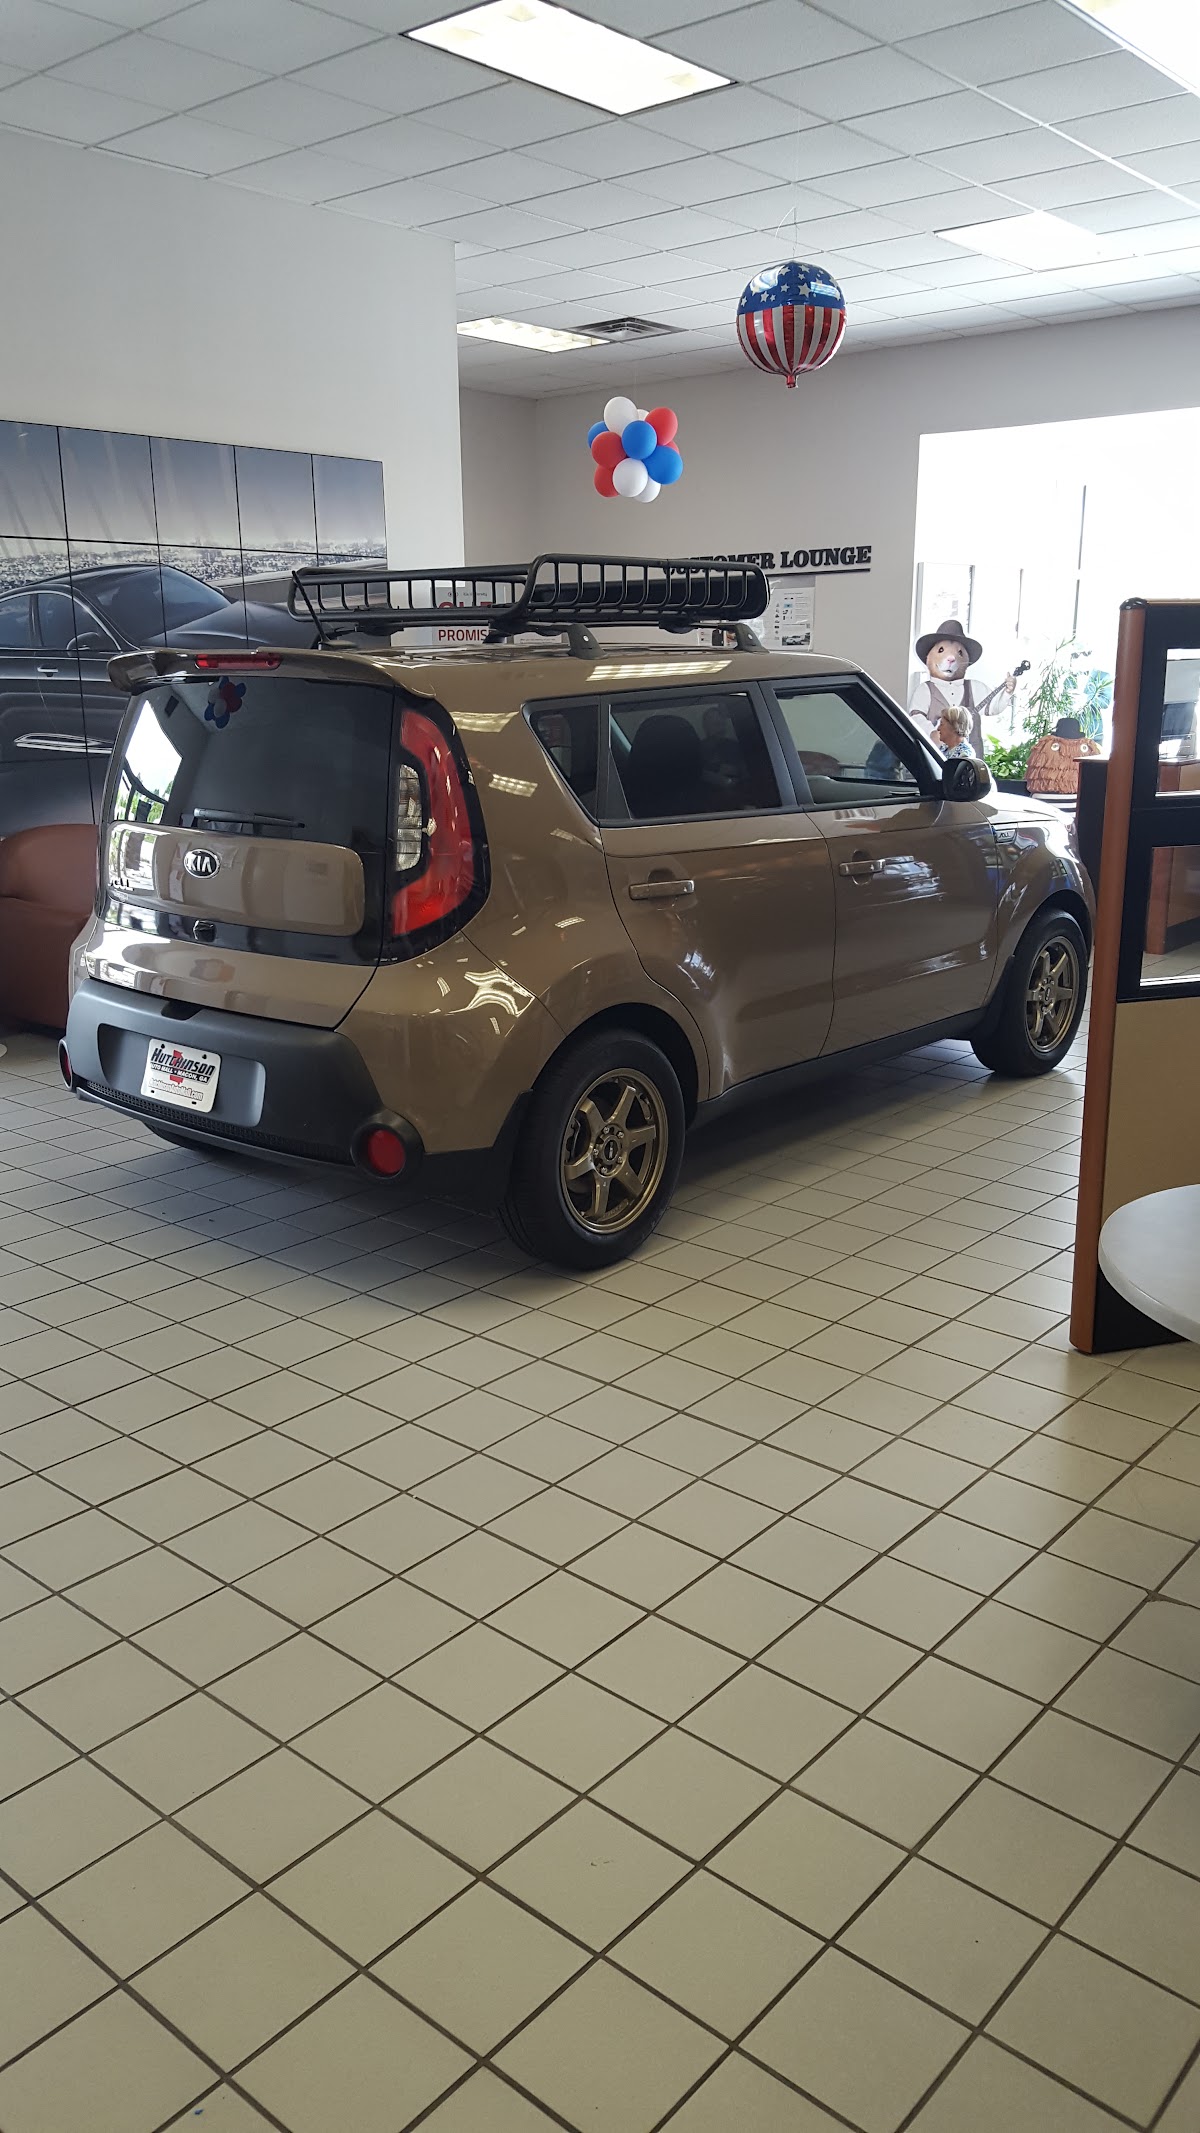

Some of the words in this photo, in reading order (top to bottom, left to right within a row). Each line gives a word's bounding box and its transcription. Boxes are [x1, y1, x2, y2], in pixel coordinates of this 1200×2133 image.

[780, 546, 872, 568] LOUNGE
[438, 629, 490, 641] PROMIS
[161, 1065, 174, 1074] MALL
[198, 1075, 209, 1083] GA
